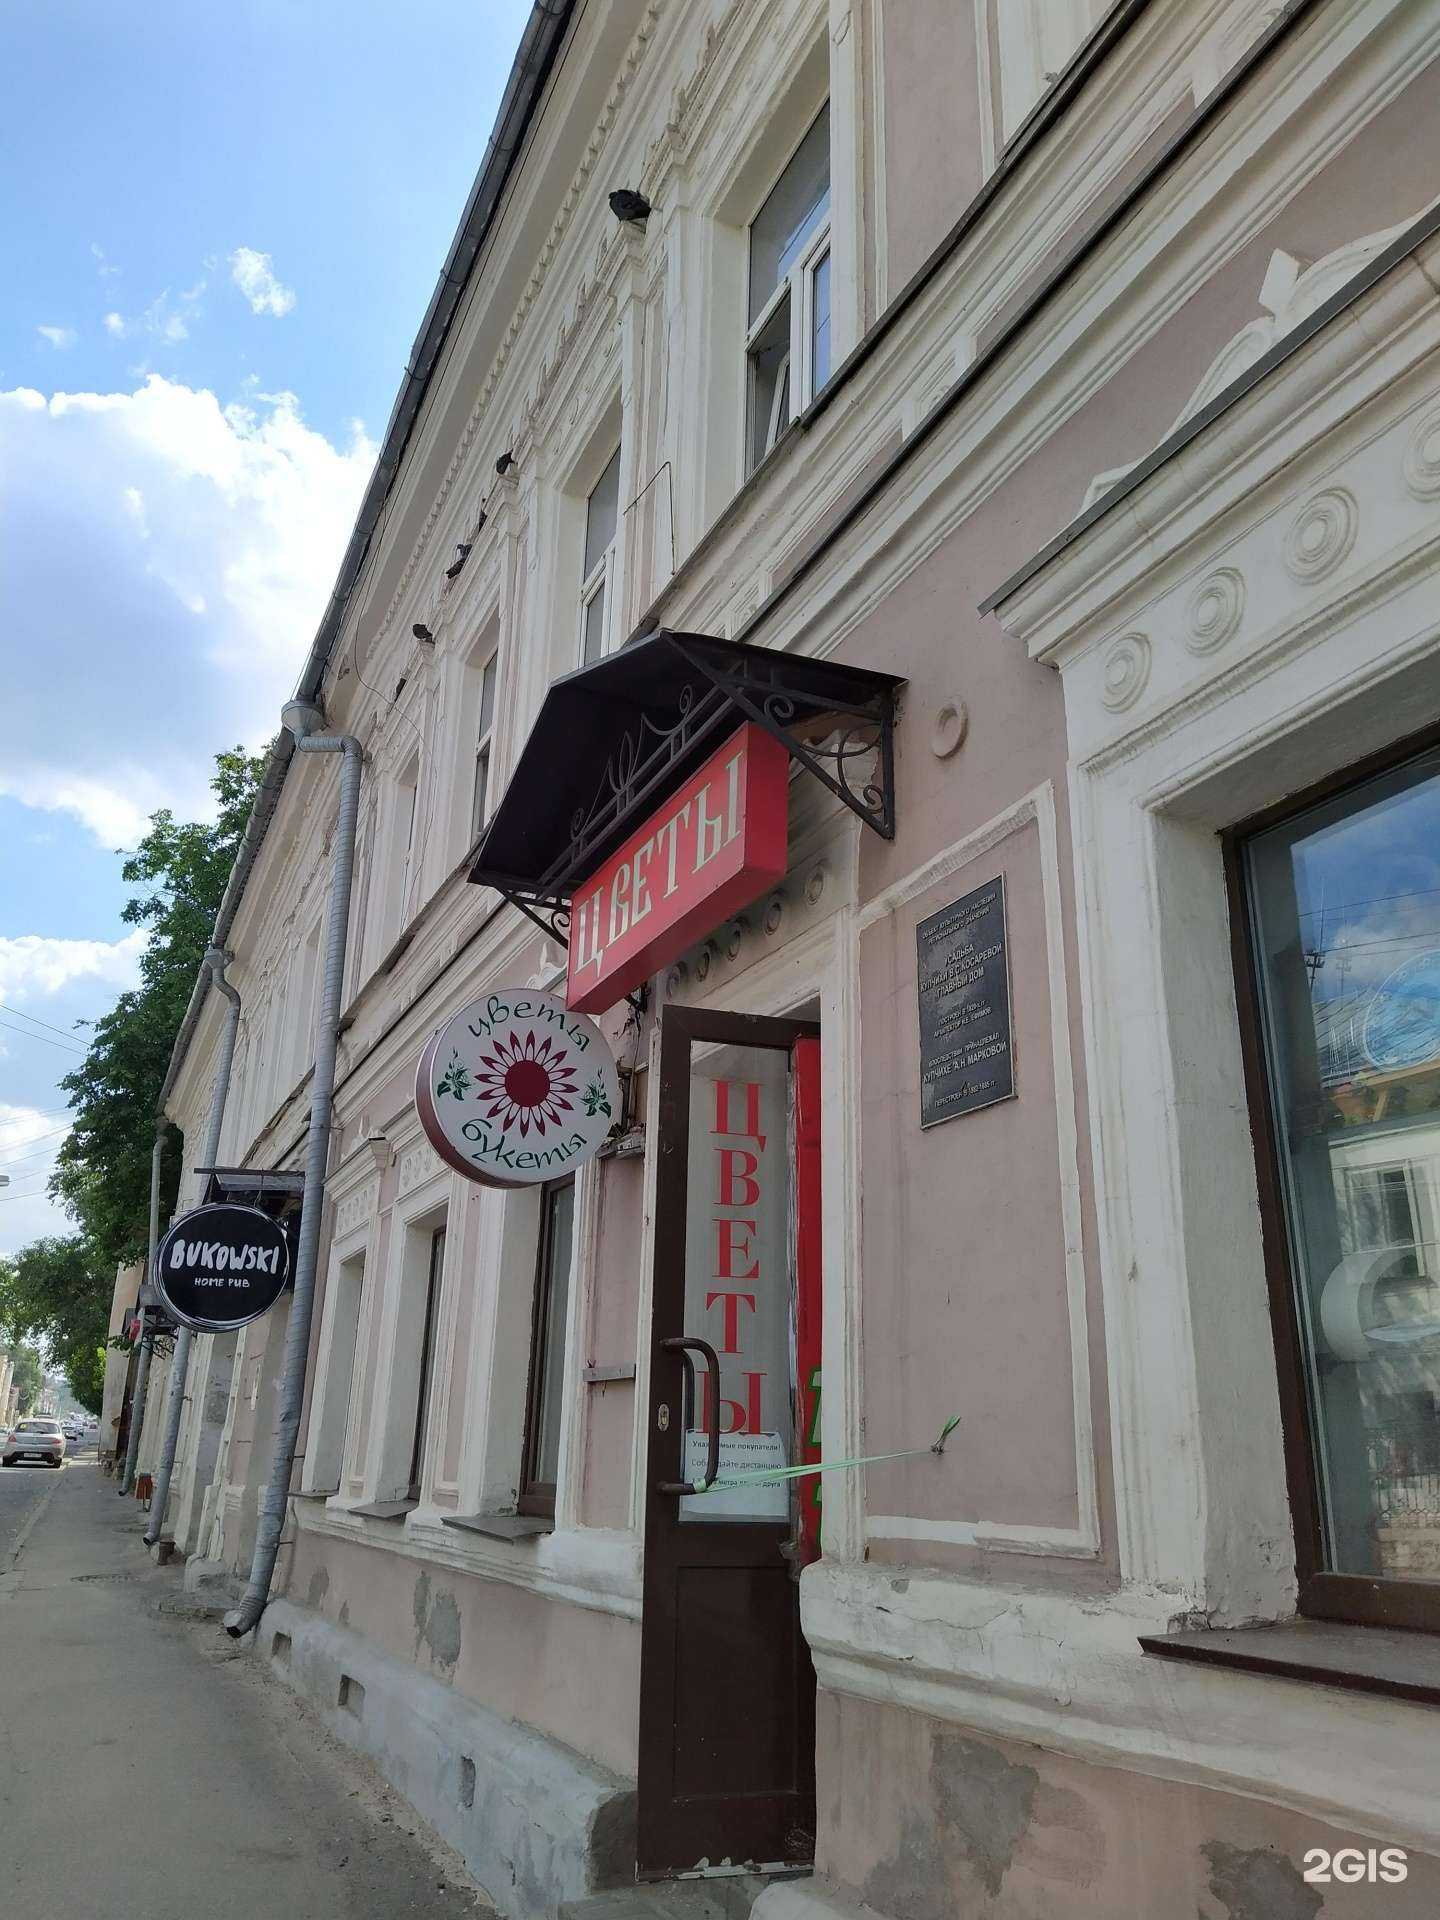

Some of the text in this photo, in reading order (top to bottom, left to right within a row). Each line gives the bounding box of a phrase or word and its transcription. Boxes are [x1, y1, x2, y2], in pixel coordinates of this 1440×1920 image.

[574, 751, 744, 978] ЦВЕТЫ
[468, 995, 590, 1052] цветы
[170, 1239, 280, 1274] BUKOWSKI
[194, 1277, 250, 1288] HOME PUB
[697, 1079, 767, 1436] ЦВЕТЫ
